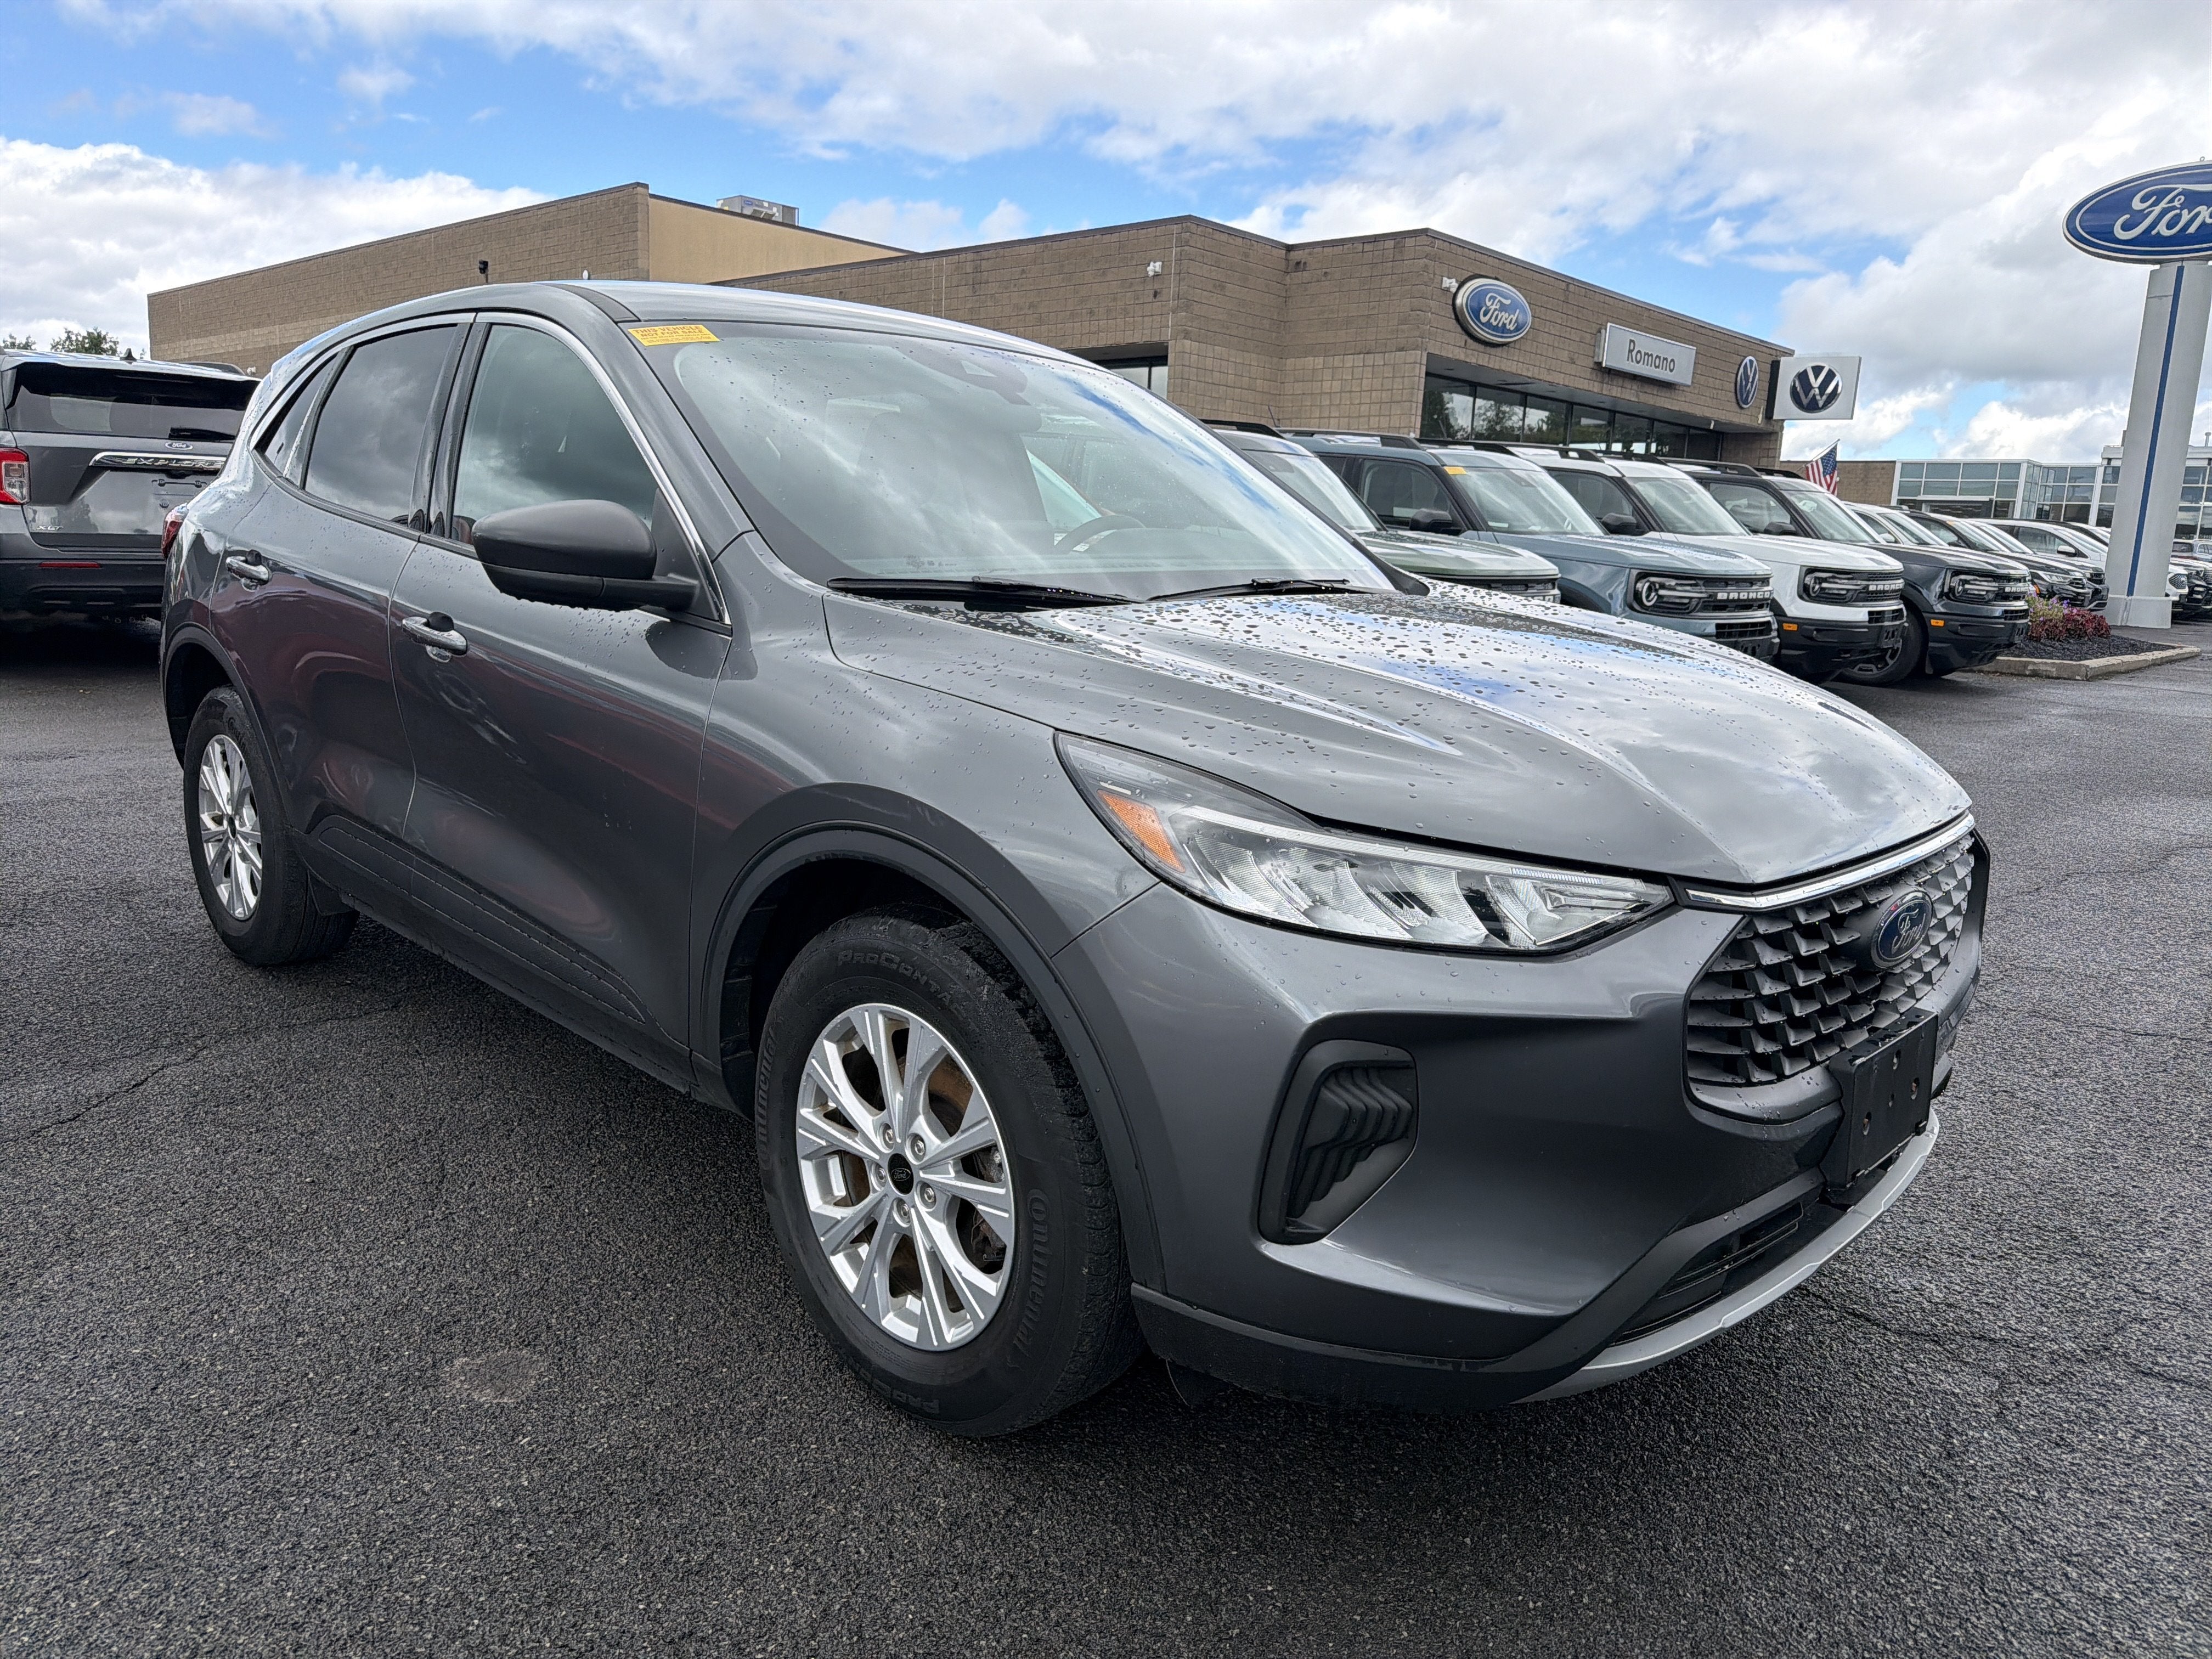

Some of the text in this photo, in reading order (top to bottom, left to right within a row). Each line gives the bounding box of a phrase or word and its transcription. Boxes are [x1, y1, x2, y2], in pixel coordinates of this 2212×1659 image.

[2114, 184, 2212, 240] For
[1480, 293, 1519, 330] Ford
[1627, 338, 1675, 373] Romano
[1717, 591, 1770, 600] BRONCO
[1891, 908, 1926, 954] Ford
[894, 1170, 906, 1180] Ford
